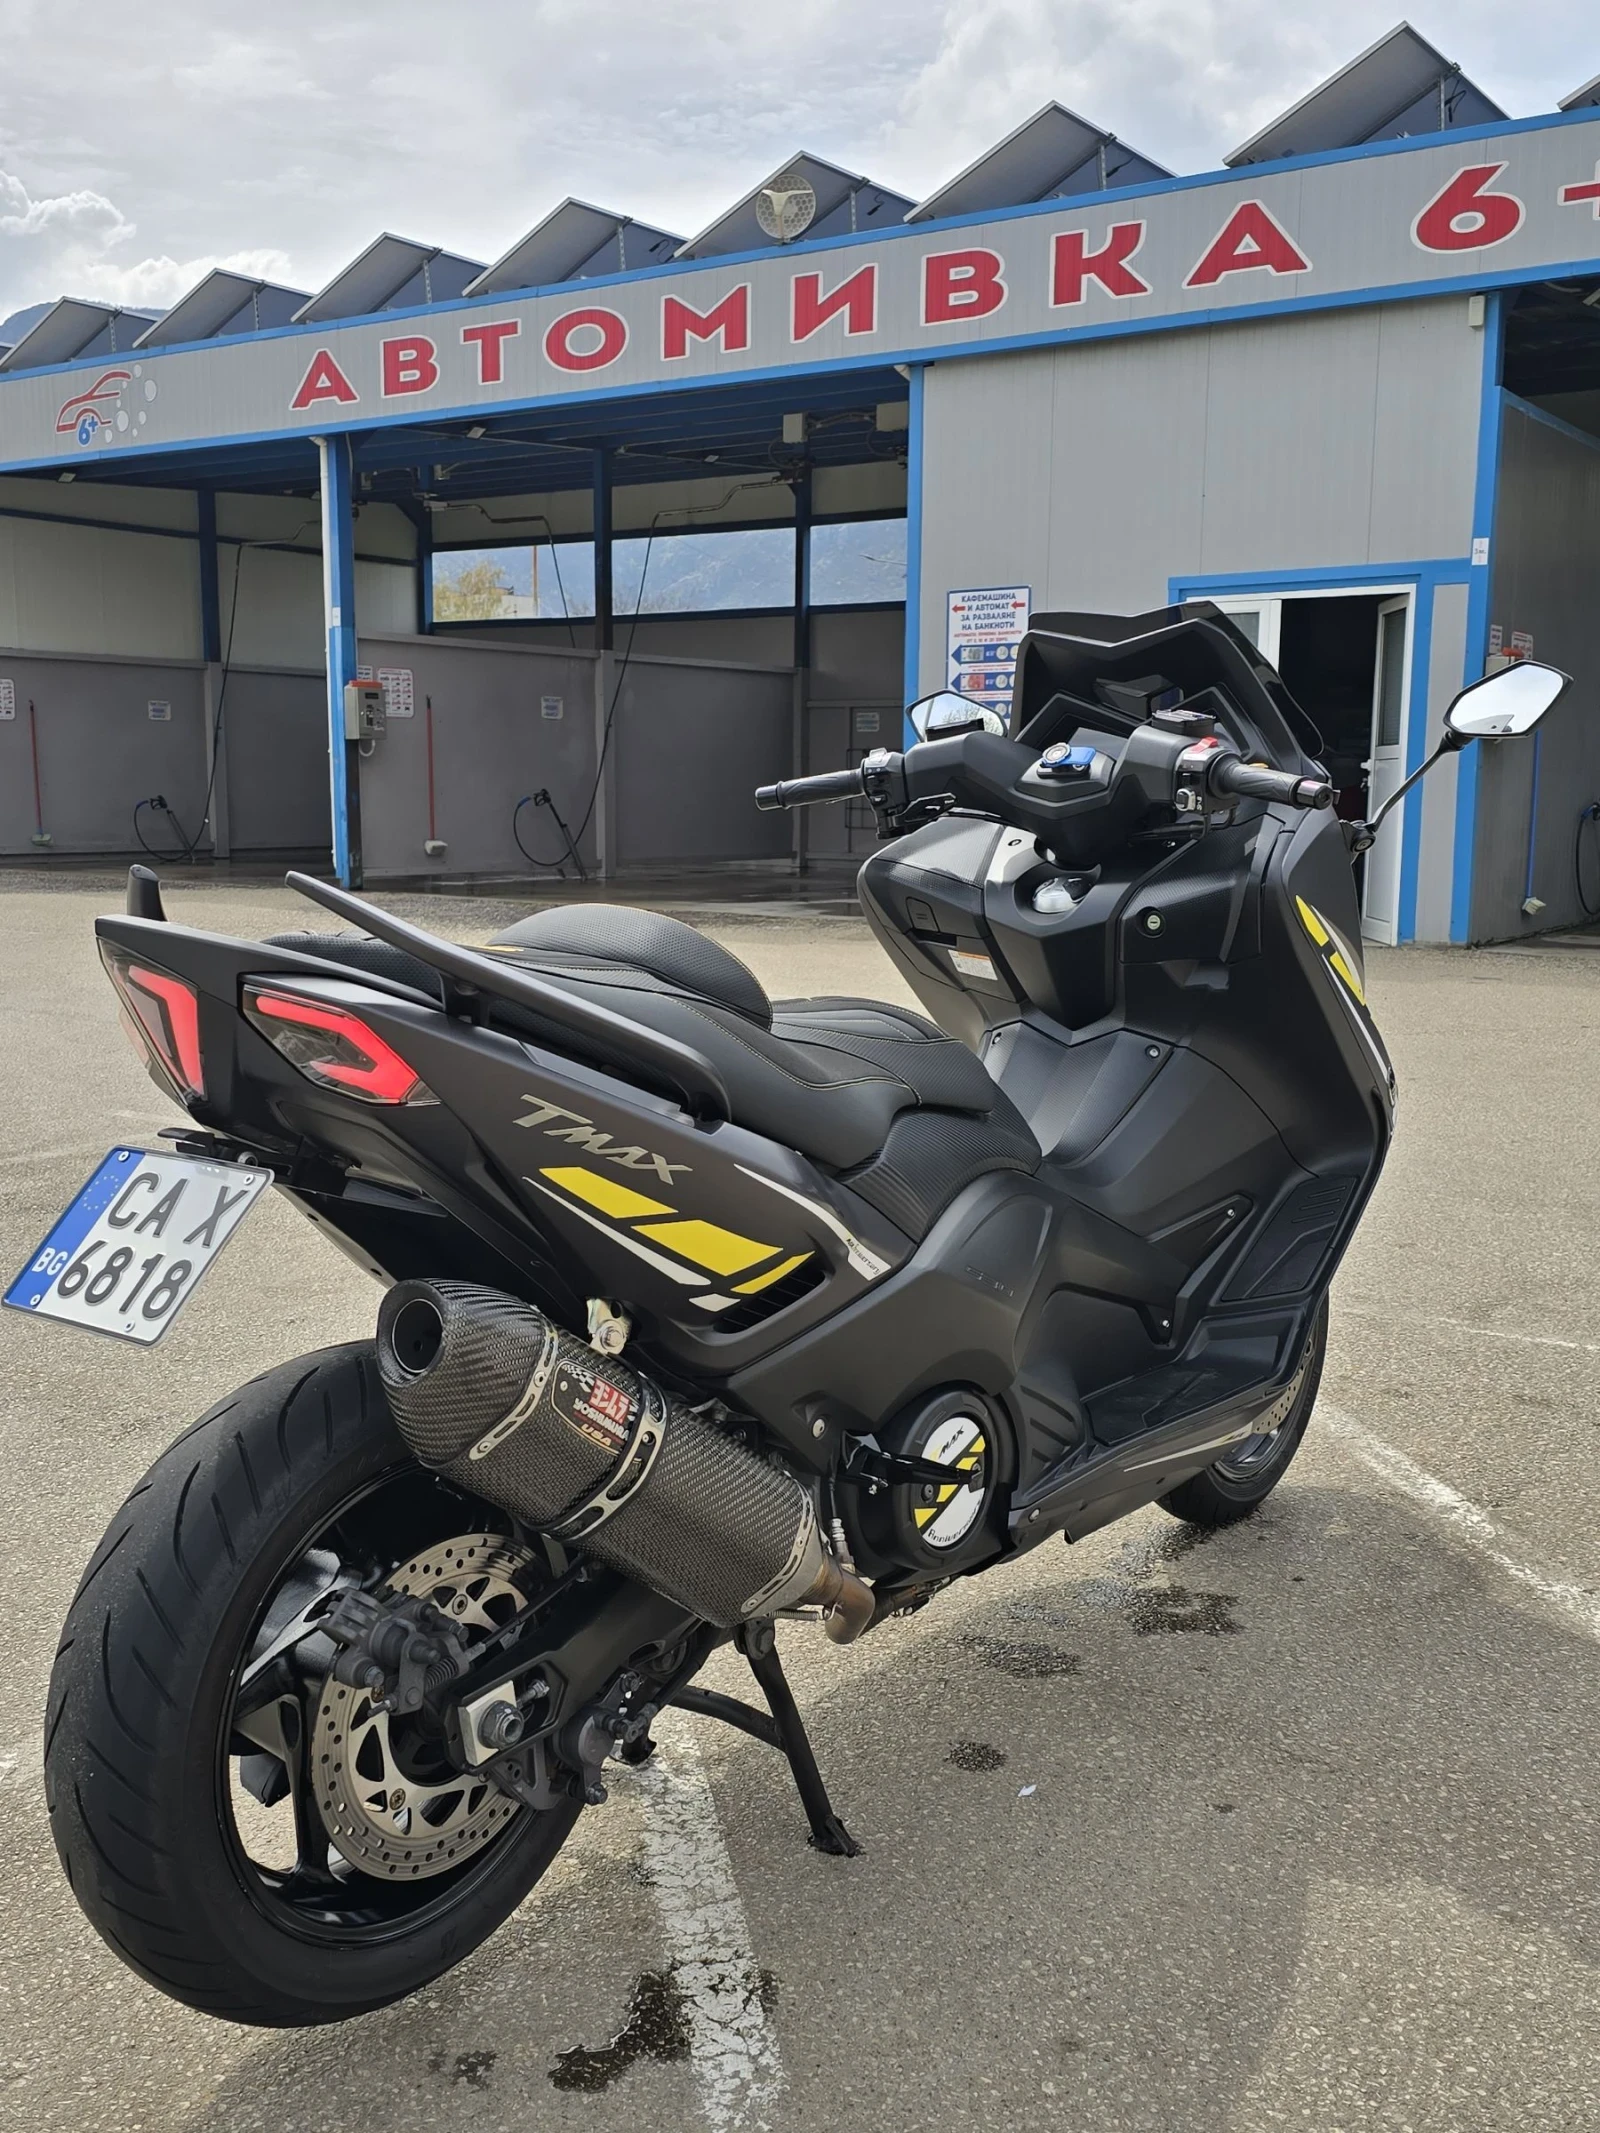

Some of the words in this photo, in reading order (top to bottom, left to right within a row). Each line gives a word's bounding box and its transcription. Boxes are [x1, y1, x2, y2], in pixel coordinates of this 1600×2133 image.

[290, 199, 1312, 410] АВТОМИВКА
[961, 592, 1016, 602] КАФЕМАШИНА
[975, 602, 1010, 611] АВТОМАТ
[960, 614, 970, 622] ЗА
[973, 611, 1016, 620] РАЗВАЛЯНЕ
[961, 623, 972, 631] НА
[975, 621, 1015, 630] БАНКНОТИ
[513, 1093, 693, 1185] TMAX
[107, 1172, 189, 1238] CA
[183, 1185, 250, 1248] X
[31, 1247, 68, 1276] BG
[57, 1240, 193, 1320] 6818
[572, 1397, 630, 1441] YOSHIMURA
